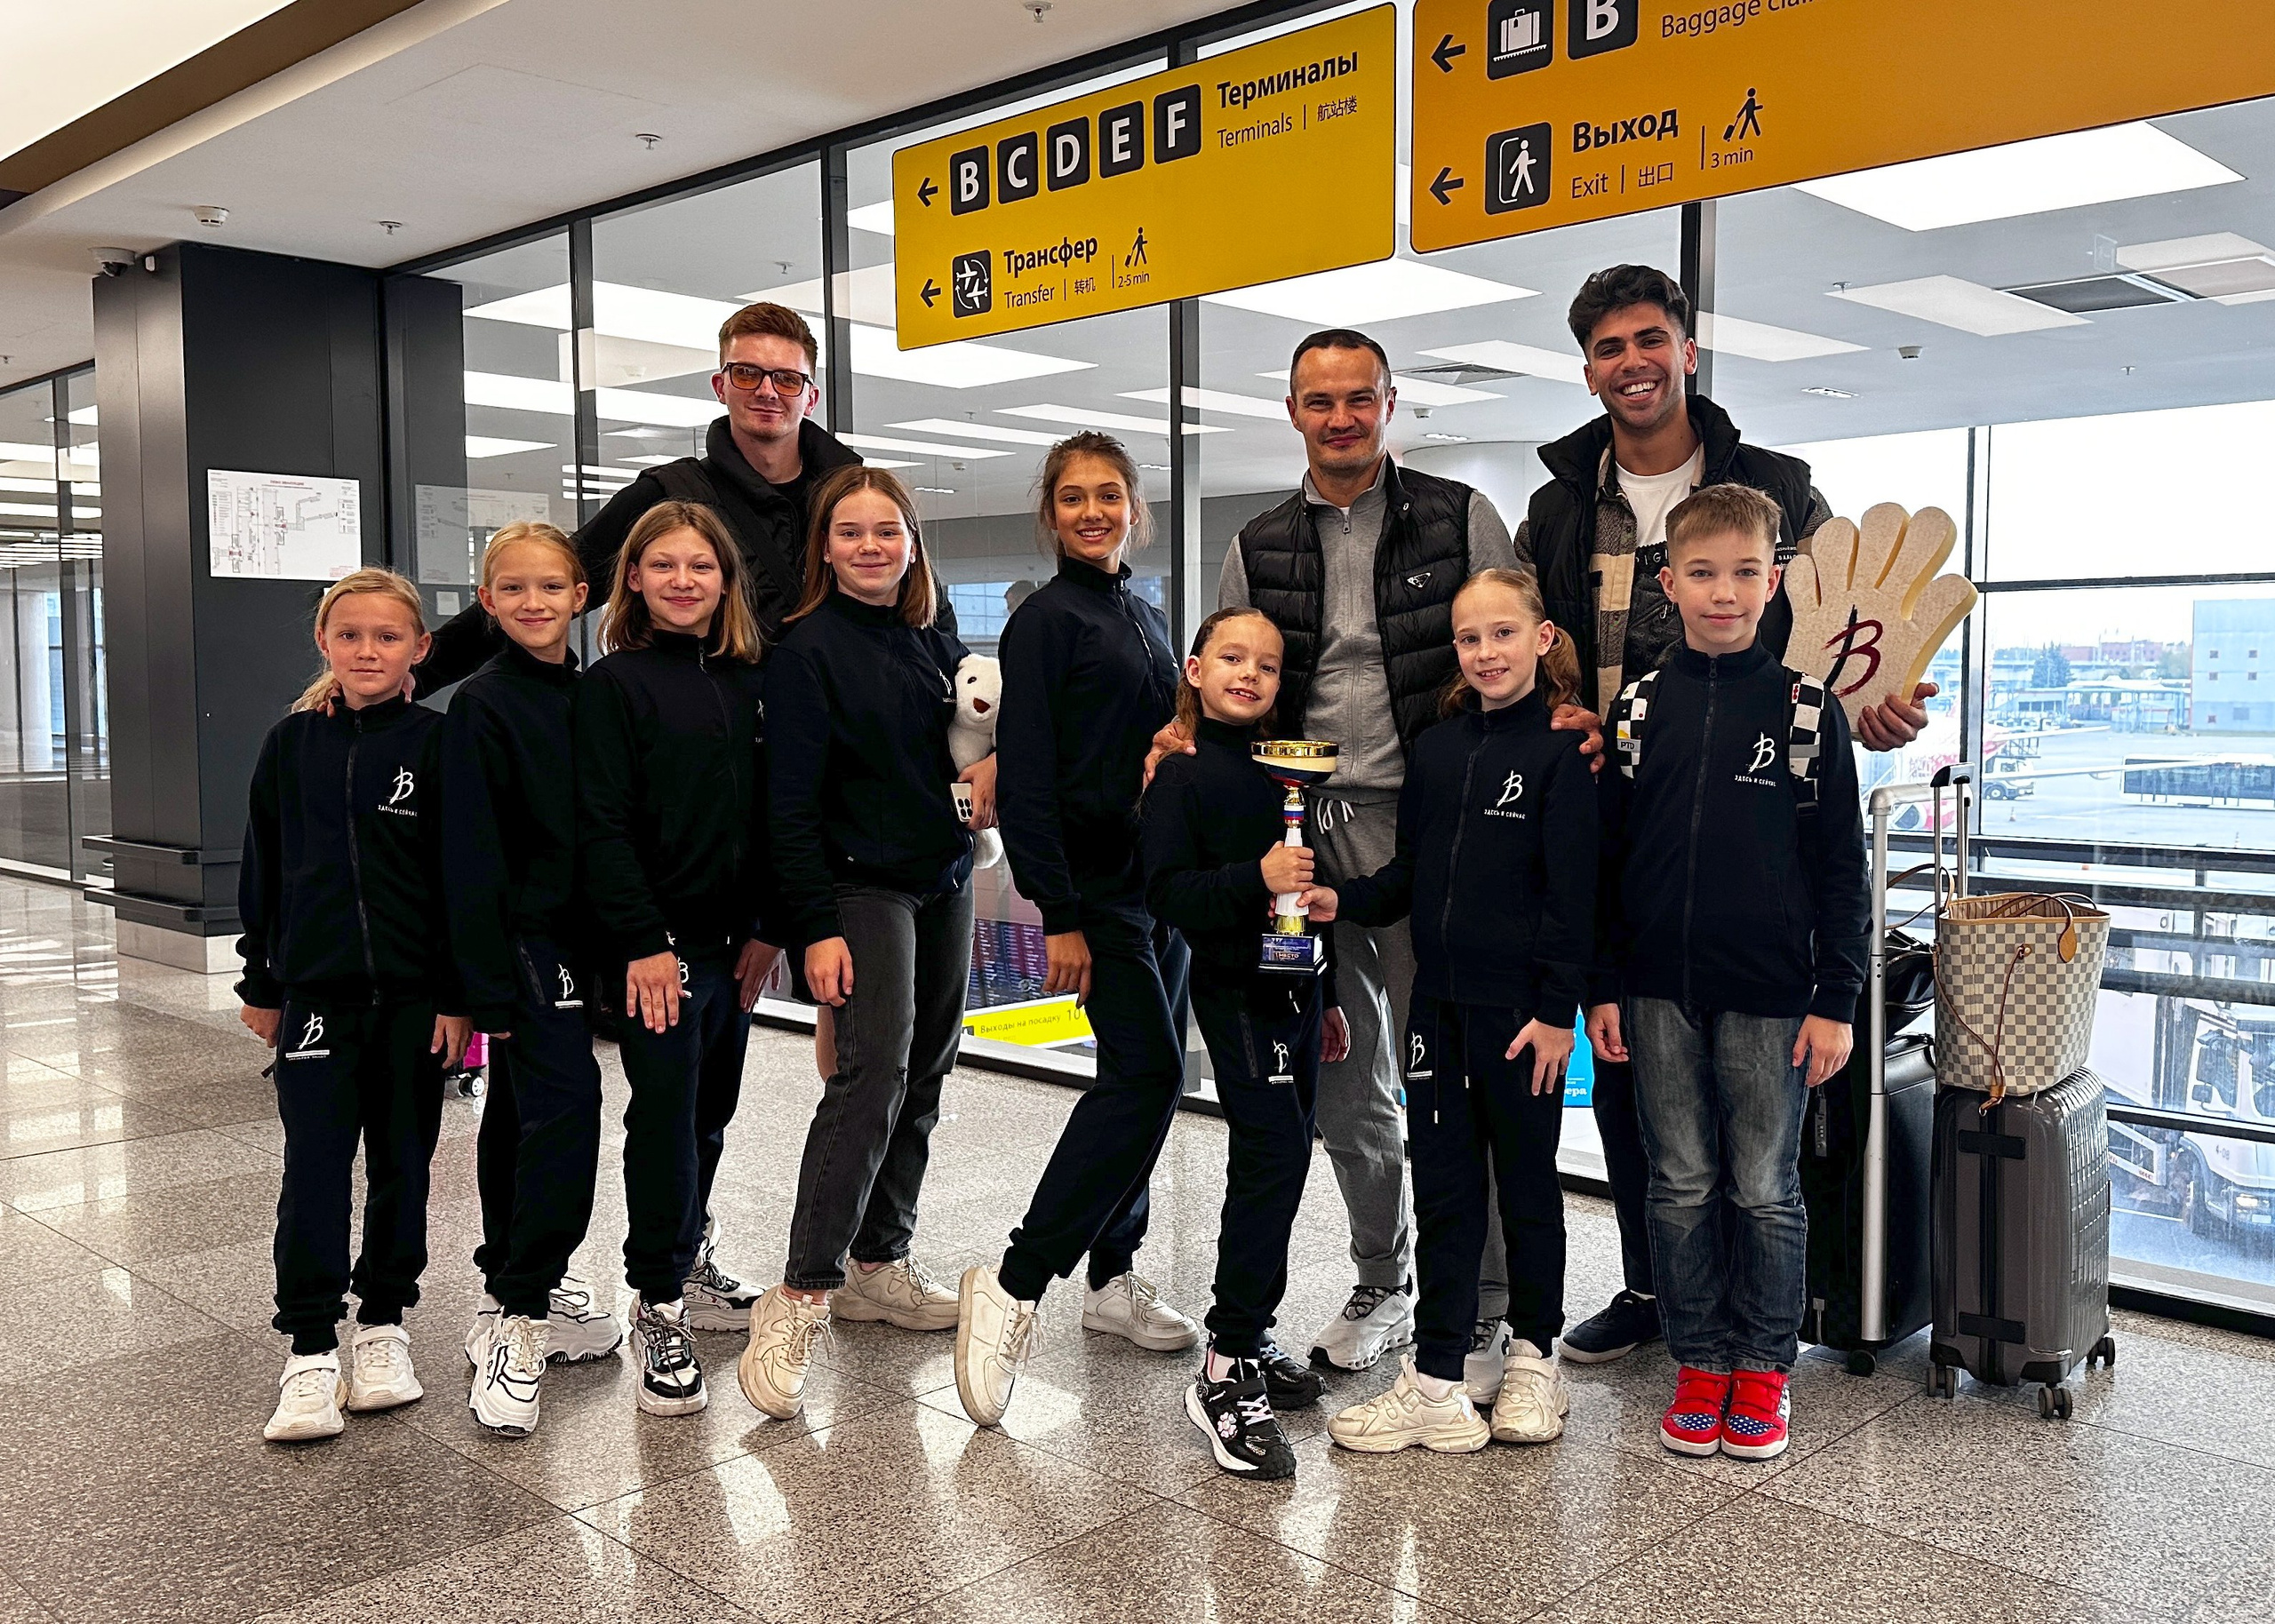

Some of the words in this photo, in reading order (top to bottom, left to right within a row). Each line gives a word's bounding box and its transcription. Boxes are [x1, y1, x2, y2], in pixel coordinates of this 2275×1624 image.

[1586, 0, 1619, 41] B
[1662, 0, 1760, 38] Baggage
[1217, 51, 1358, 110] Терминалы
[1317, 94, 1358, 122] 航站楼
[1217, 112, 1292, 148] Terminals
[1572, 108, 1679, 153] Выход
[960, 161, 978, 203] B
[1007, 146, 1027, 188] C
[1056, 134, 1081, 178] D
[1112, 116, 1131, 163] E
[1168, 100, 1186, 148] F
[1711, 152, 1720, 169] 3
[1723, 147, 1753, 166] min
[1571, 172, 1608, 199] Exit
[1638, 162, 1673, 187] 出口
[1003, 236, 1098, 279] Трансфер
[1074, 277, 1097, 295] 转机
[1118, 274, 1132, 289] 2-5
[1132, 271, 1150, 285] min
[1004, 283, 1055, 309] Transfer
[980, 1023, 1015, 1034] Выходы
[1028, 1014, 1061, 1025] посадку
